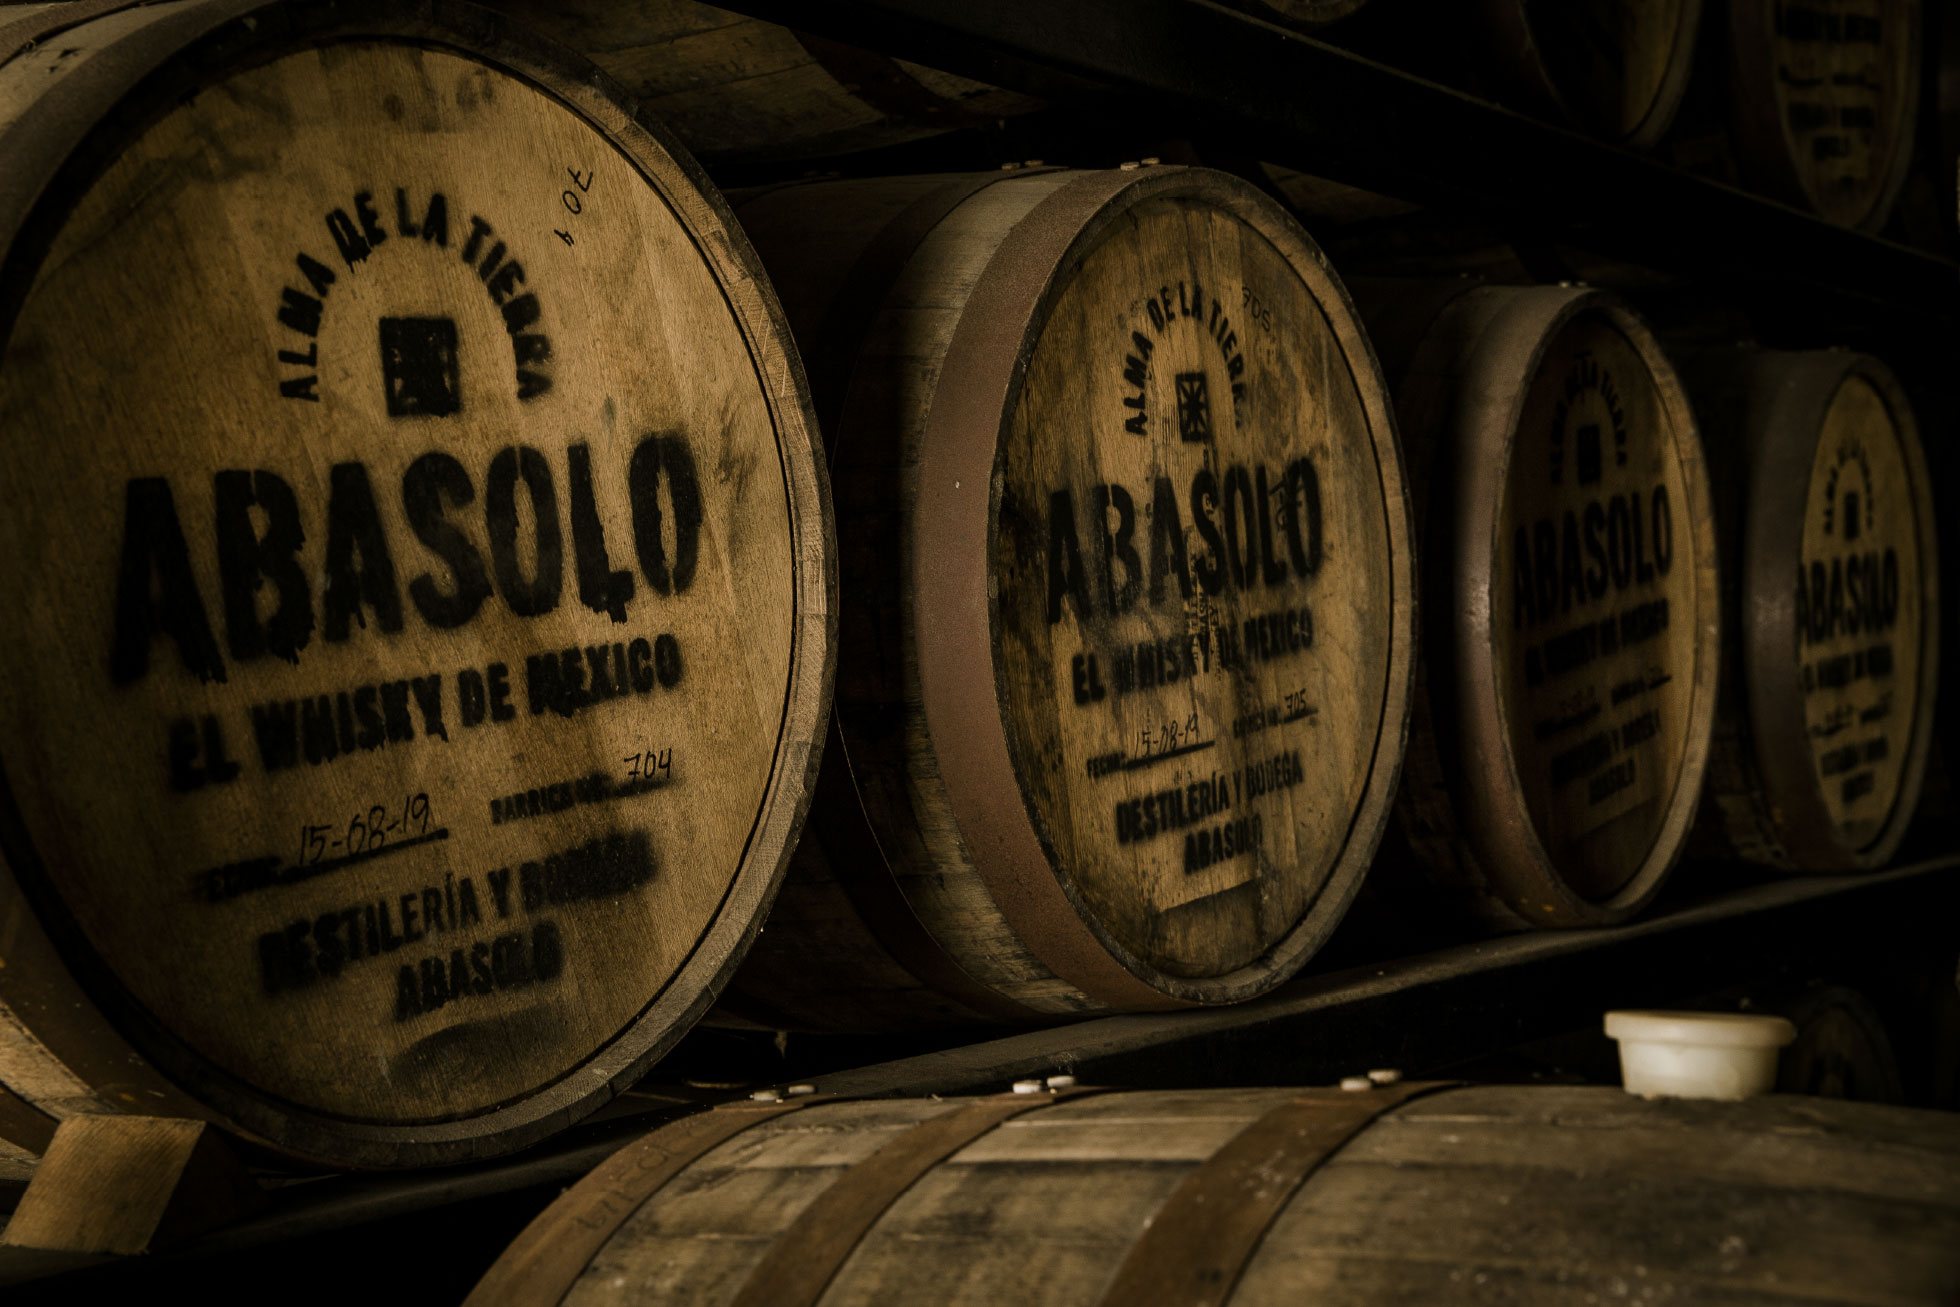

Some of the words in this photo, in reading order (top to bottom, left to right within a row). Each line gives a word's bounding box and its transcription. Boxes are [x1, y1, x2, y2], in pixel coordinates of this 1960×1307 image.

[552, 165, 595, 248] 704
[277, 251, 337, 402] ALMA
[395, 188, 449, 248] LA
[1123, 330, 1153, 437] ALMA
[1146, 285, 1175, 334] DE
[1179, 280, 1203, 321] LA
[108, 431, 703, 688] ABASOLO
[1049, 456, 1322, 625] ABASOLO
[1515, 484, 1672, 629] ABASOLO
[171, 713, 241, 793] EL
[252, 674, 449, 772] WHISKY
[458, 661, 516, 727] DE
[526, 633, 683, 718] MEXICO
[1072, 653, 1105, 703] EL
[623, 748, 673, 783] 704
[1233, 770, 1242, 805] Y
[487, 867, 510, 919] Y
